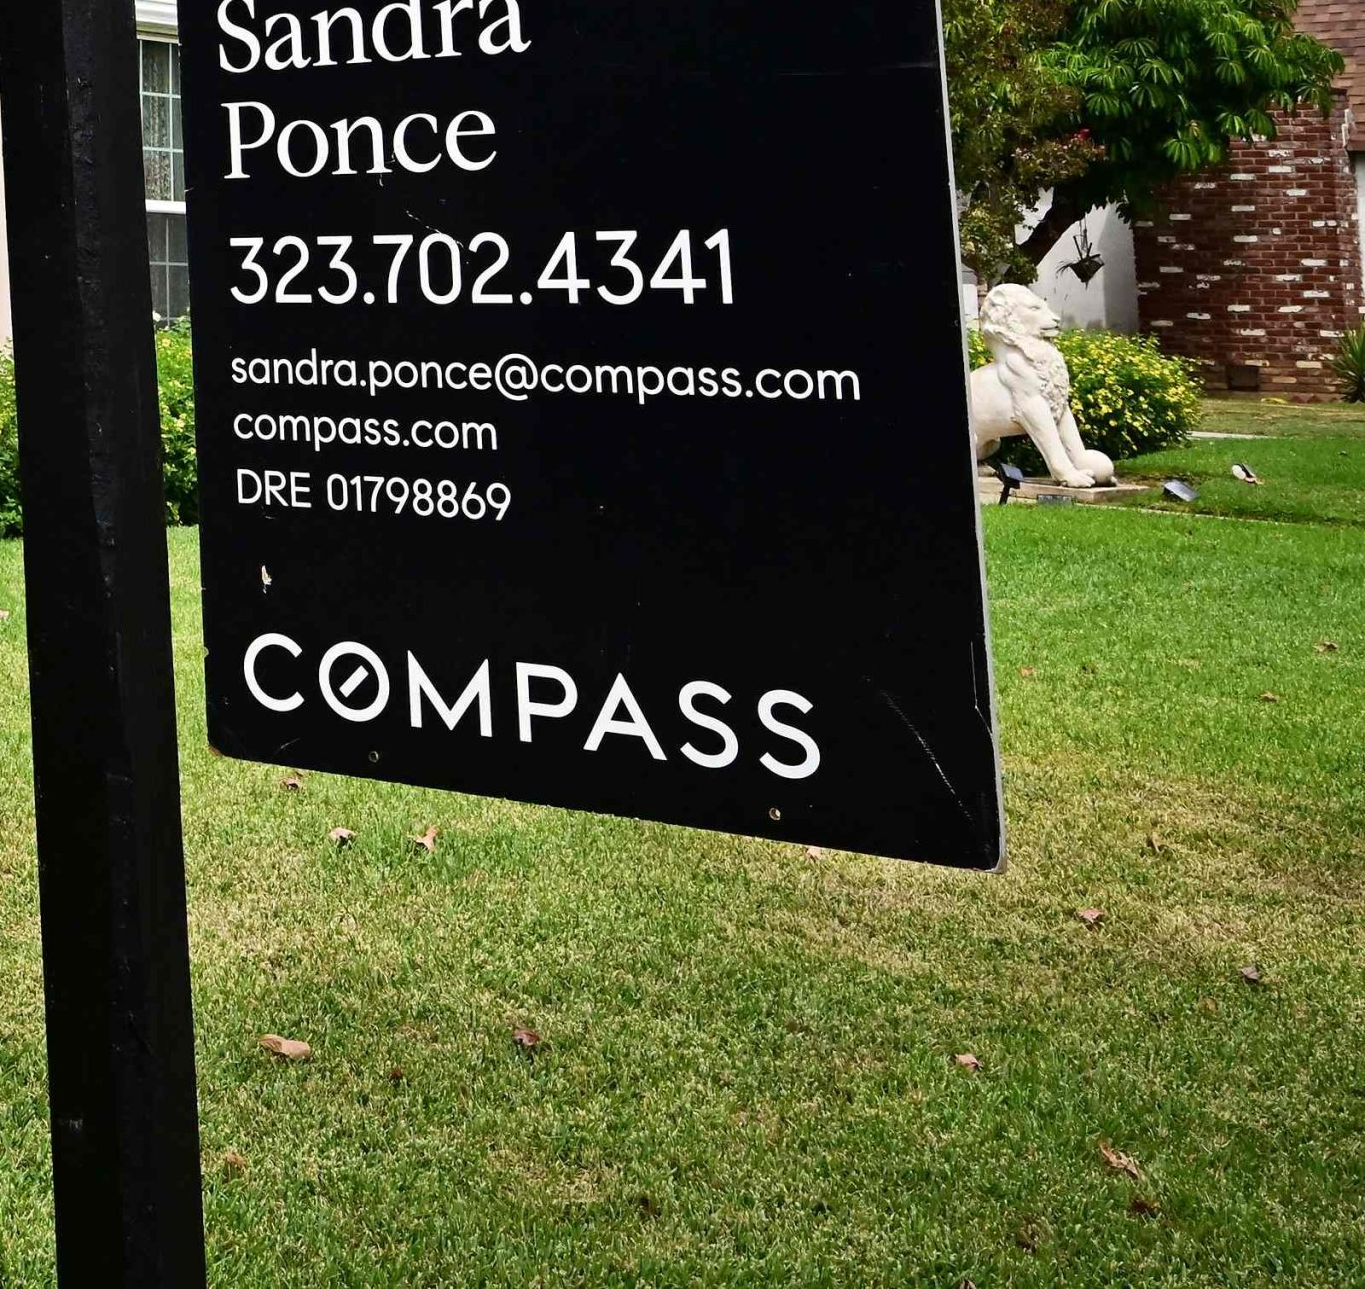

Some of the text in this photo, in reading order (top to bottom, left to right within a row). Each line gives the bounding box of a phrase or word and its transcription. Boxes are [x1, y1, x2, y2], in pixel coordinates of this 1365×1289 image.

[219, 100, 498, 179] Ponce
[228, 228, 735, 306] 323.702.4341
[230, 347, 862, 402] sandra.ponce@compass.com
[233, 412, 498, 452] compass.com
[235, 468, 512, 522] DRE 01798869
[242, 631, 821, 780] COMPASS
